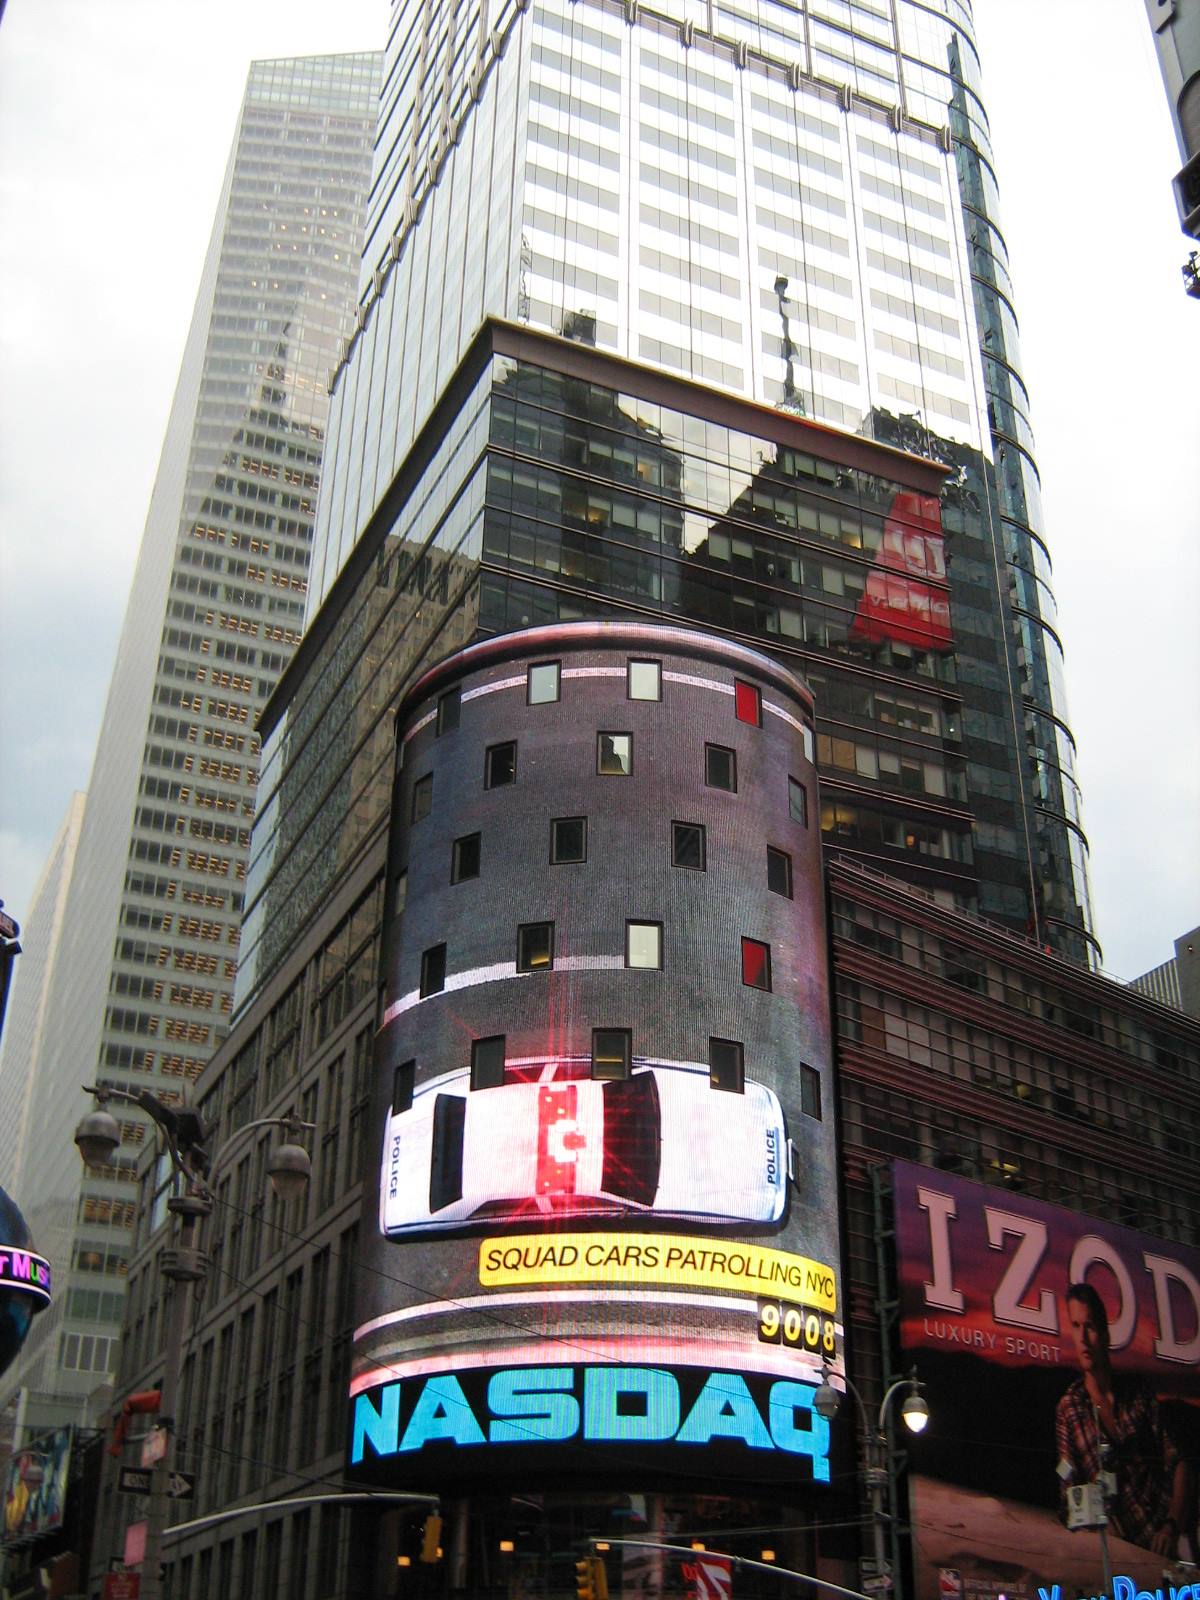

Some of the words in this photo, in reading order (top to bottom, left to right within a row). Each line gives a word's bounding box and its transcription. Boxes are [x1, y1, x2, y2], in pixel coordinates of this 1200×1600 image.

[390, 1136, 401, 1199] POLICE
[766, 1129, 776, 1184] POLICE
[486, 1246, 578, 1271] SQUAD
[585, 1245, 659, 1269] CARS
[665, 1248, 801, 1287] PATROLLING
[805, 1271, 834, 1298] NYC
[917, 1185, 1200, 1365] IZOD
[761, 1304, 835, 1351] 9008
[924, 1318, 997, 1349] LUXURY
[1005, 1337, 1060, 1362] SPORT
[351, 1367, 831, 1484] NASDAQ
